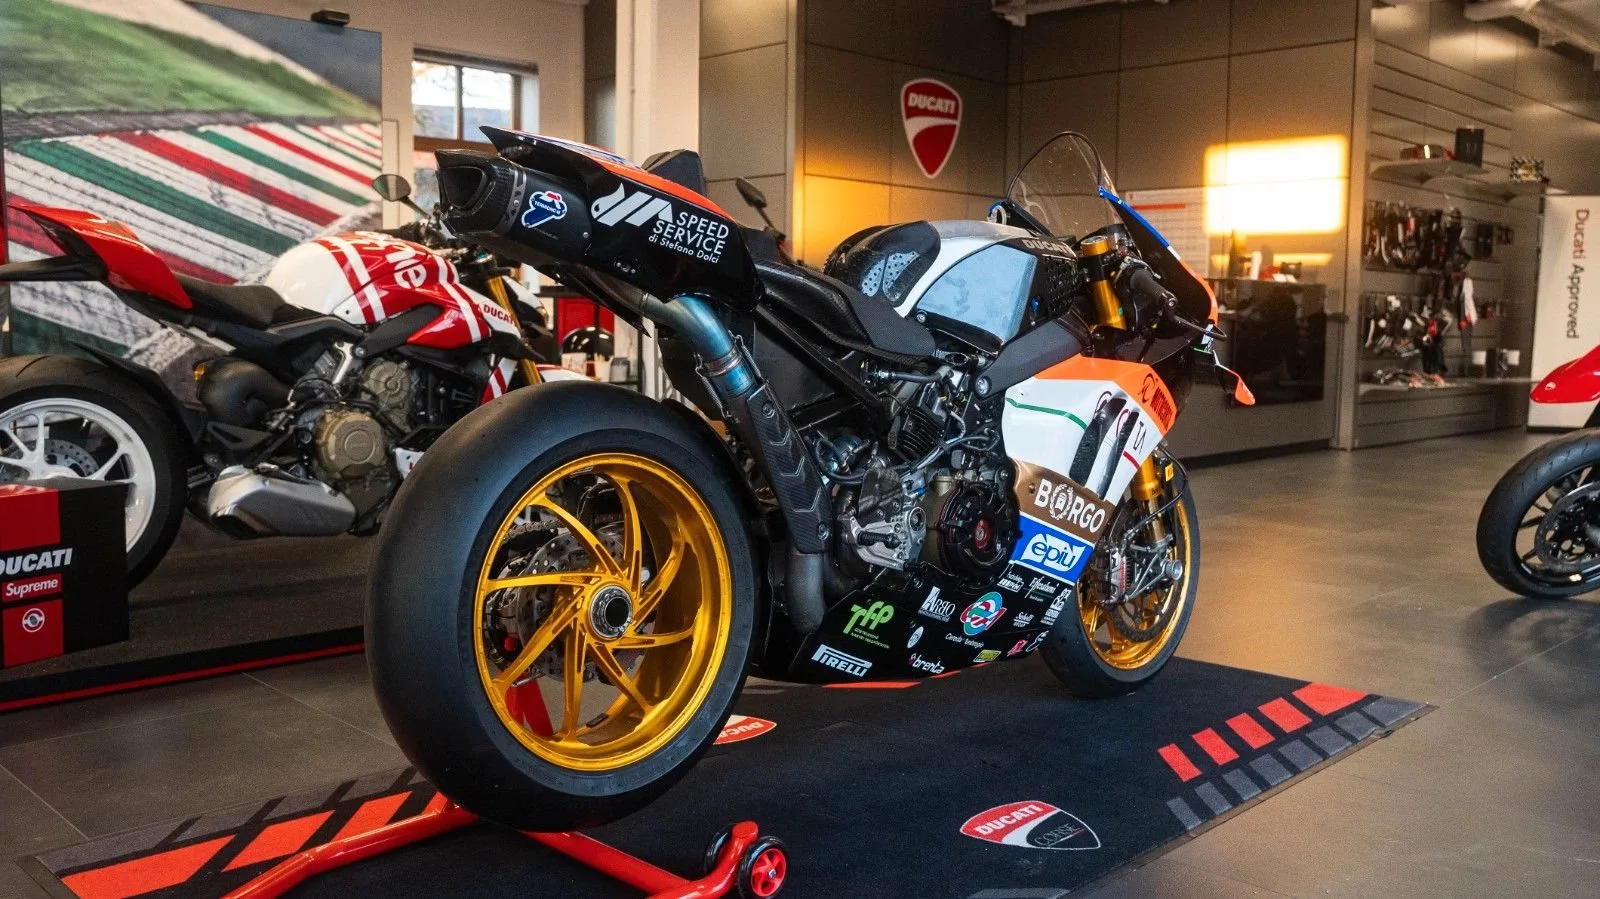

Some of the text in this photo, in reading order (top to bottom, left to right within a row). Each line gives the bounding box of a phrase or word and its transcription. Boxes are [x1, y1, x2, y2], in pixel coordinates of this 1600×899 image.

[908, 92, 956, 114] DUCATI
[653, 220, 726, 255] SERVICE
[676, 212, 729, 239] SPEED
[648, 234, 720, 264] di Stefano Dolci
[1567, 208, 1590, 339] Ducati Approved
[1034, 478, 1106, 533] BORGO
[5, 579, 59, 598] Supreme
[811, 643, 873, 677] PIRELLI
[912, 654, 945, 674] brenta
[974, 804, 1044, 836] DUCATI
